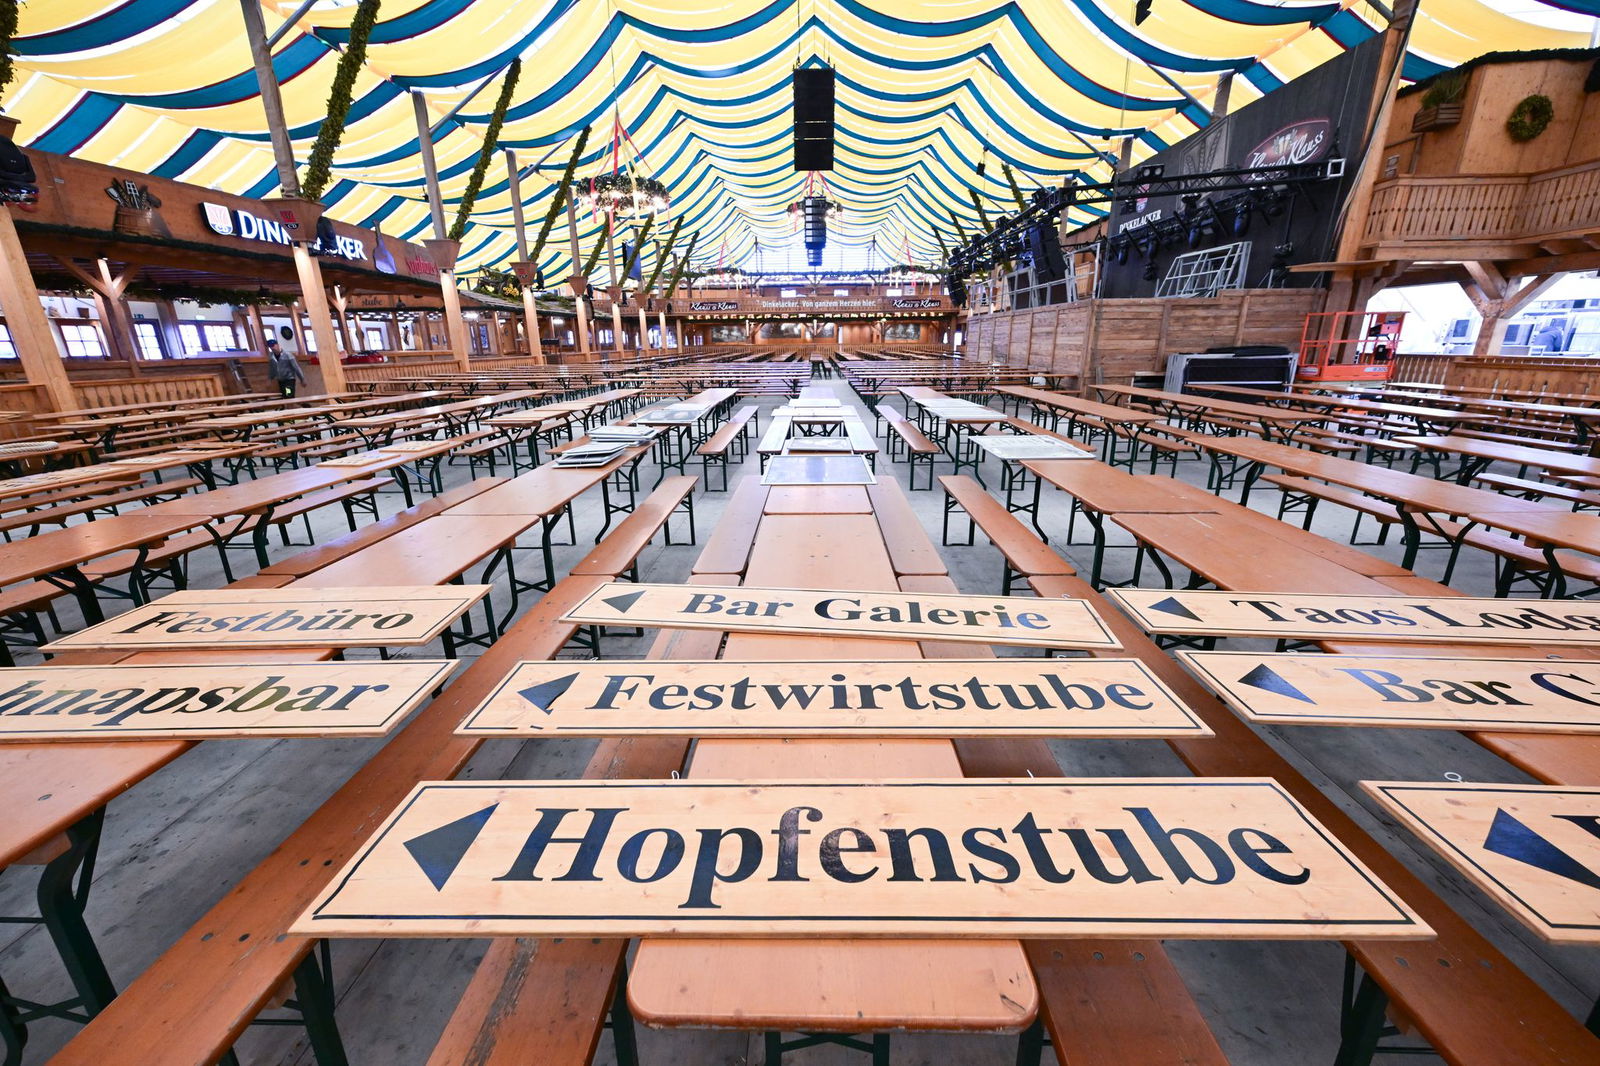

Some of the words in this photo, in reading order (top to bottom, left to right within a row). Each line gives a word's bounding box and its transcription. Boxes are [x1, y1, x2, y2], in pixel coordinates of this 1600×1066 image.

[112, 608, 414, 634] Festbüro
[680, 593, 794, 617] Bar
[814, 598, 1050, 631] Galerie
[1229, 600, 1417, 626] Taos
[0, 676, 389, 727] hnapsbar
[585, 672, 1155, 711] Festwirtstube
[1334, 668, 1533, 706] Bar
[492, 806, 1311, 909] Hopfenstube
